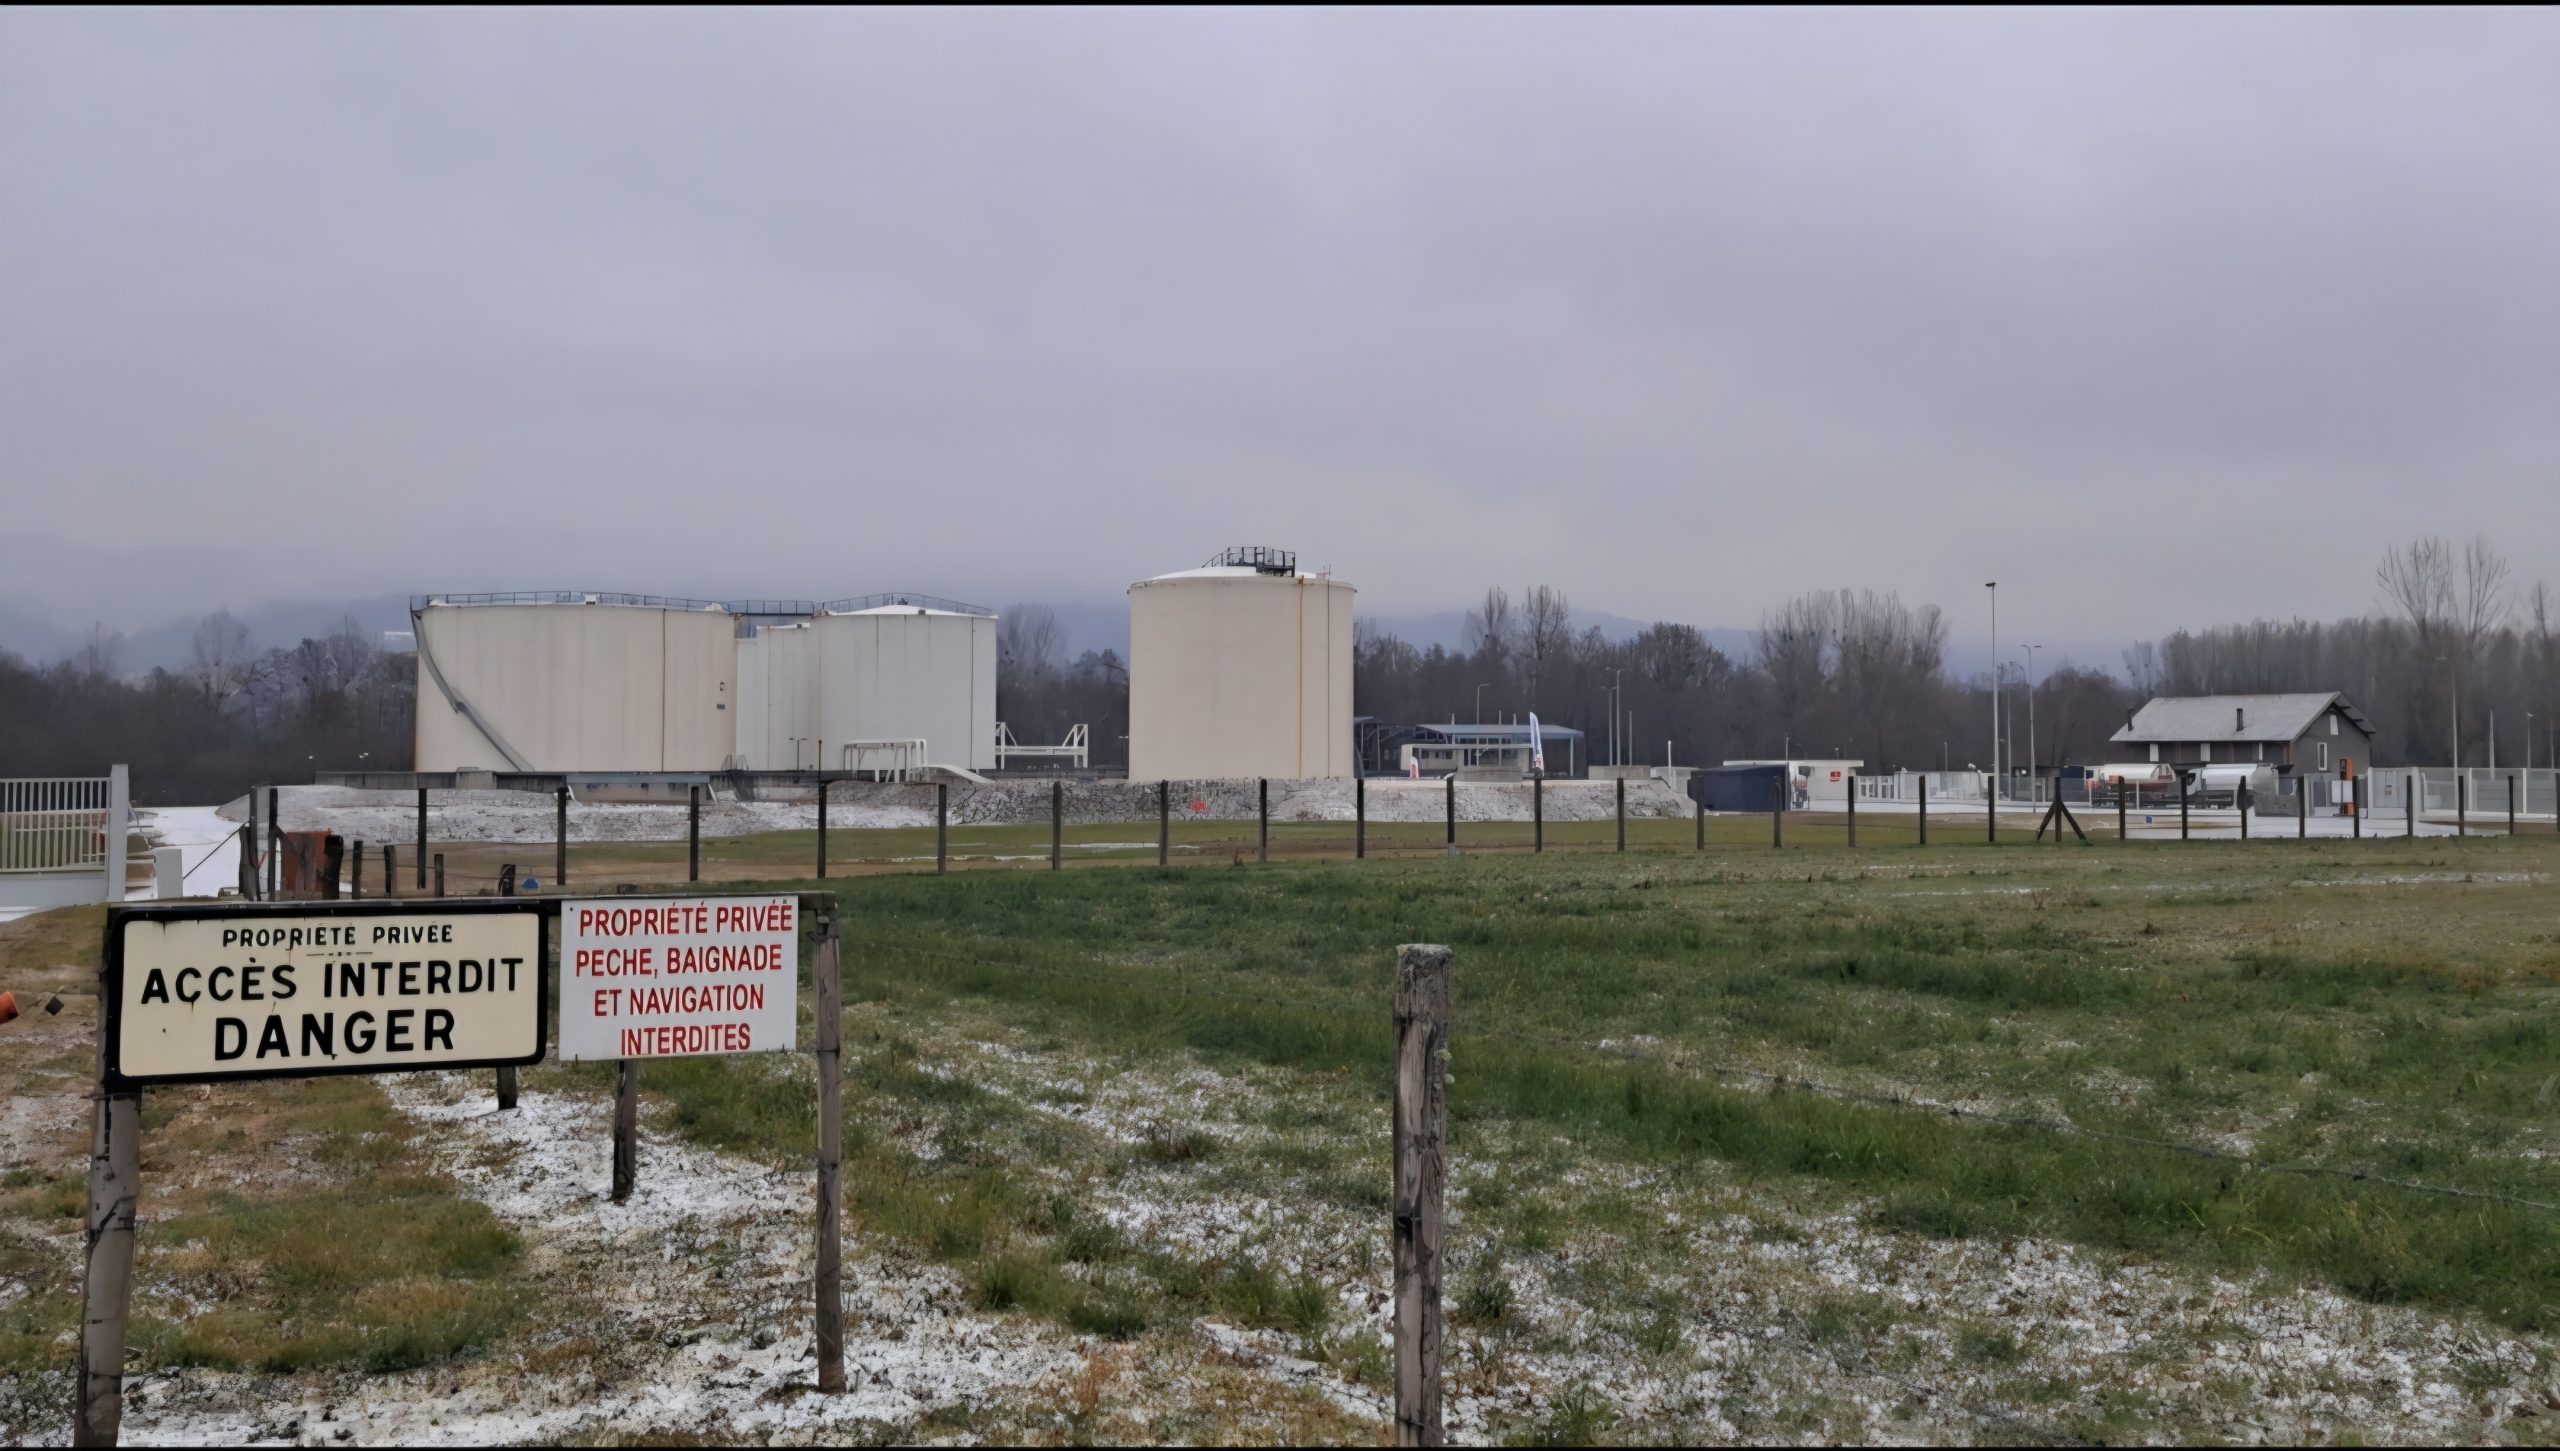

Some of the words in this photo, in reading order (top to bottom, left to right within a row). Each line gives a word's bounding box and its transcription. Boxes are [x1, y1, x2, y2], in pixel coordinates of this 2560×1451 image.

[580, 901, 708, 937] PROPRIÉTÉ
[716, 899, 792, 933] PRIVÉE
[576, 948, 658, 979] PECHE,
[667, 944, 782, 974] BAIGNADE
[141, 957, 297, 1004] ACCÈS
[324, 958, 523, 998] INTERDIT
[594, 989, 622, 1016] ET
[630, 983, 764, 1015] NAVIGATION
[215, 1008, 454, 1060] DANGER
[621, 1023, 750, 1056] INTERDITES
